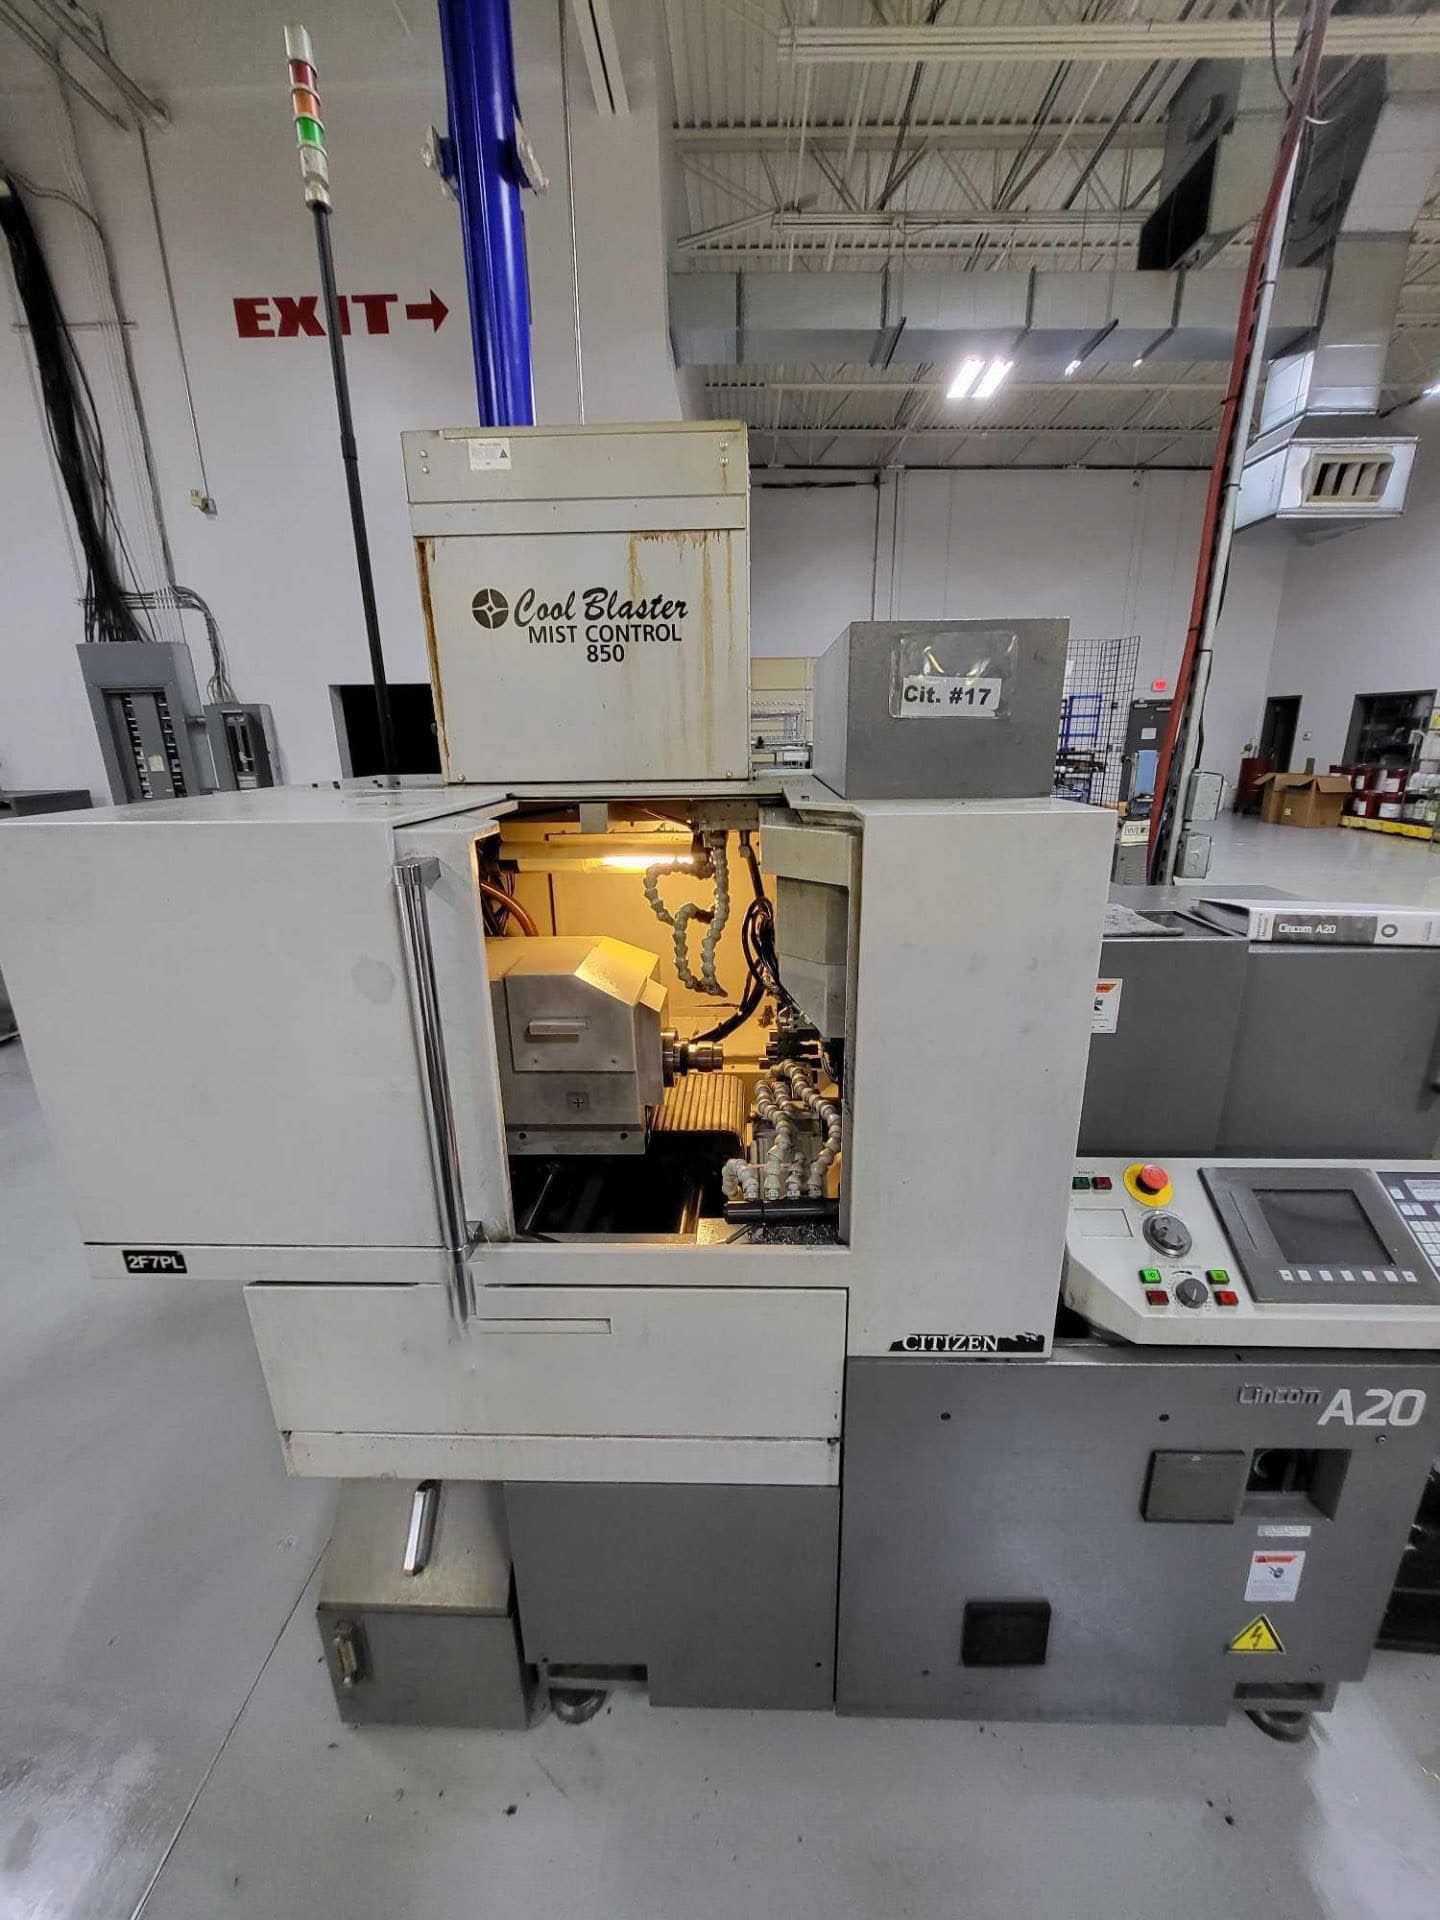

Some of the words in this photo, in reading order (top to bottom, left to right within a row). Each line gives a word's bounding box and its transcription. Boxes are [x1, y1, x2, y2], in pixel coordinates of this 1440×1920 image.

[233, 294, 398, 338] EXIT
[513, 588, 576, 627] Cool
[582, 587, 688, 621] Blaster
[528, 625, 577, 643] MIST
[585, 624, 682, 643] CONTROL
[586, 644, 625, 662] 850
[904, 685, 941, 703] Cit.
[949, 687, 992, 705] #17
[1278, 923, 1313, 934] Cincom
[1315, 924, 1337, 934] A20
[127, 1255, 185, 1269] 2F7PL
[902, 1334, 999, 1351] CITIZEN
[1238, 1382, 1321, 1405] Cincom
[1317, 1388, 1427, 1426] A20
